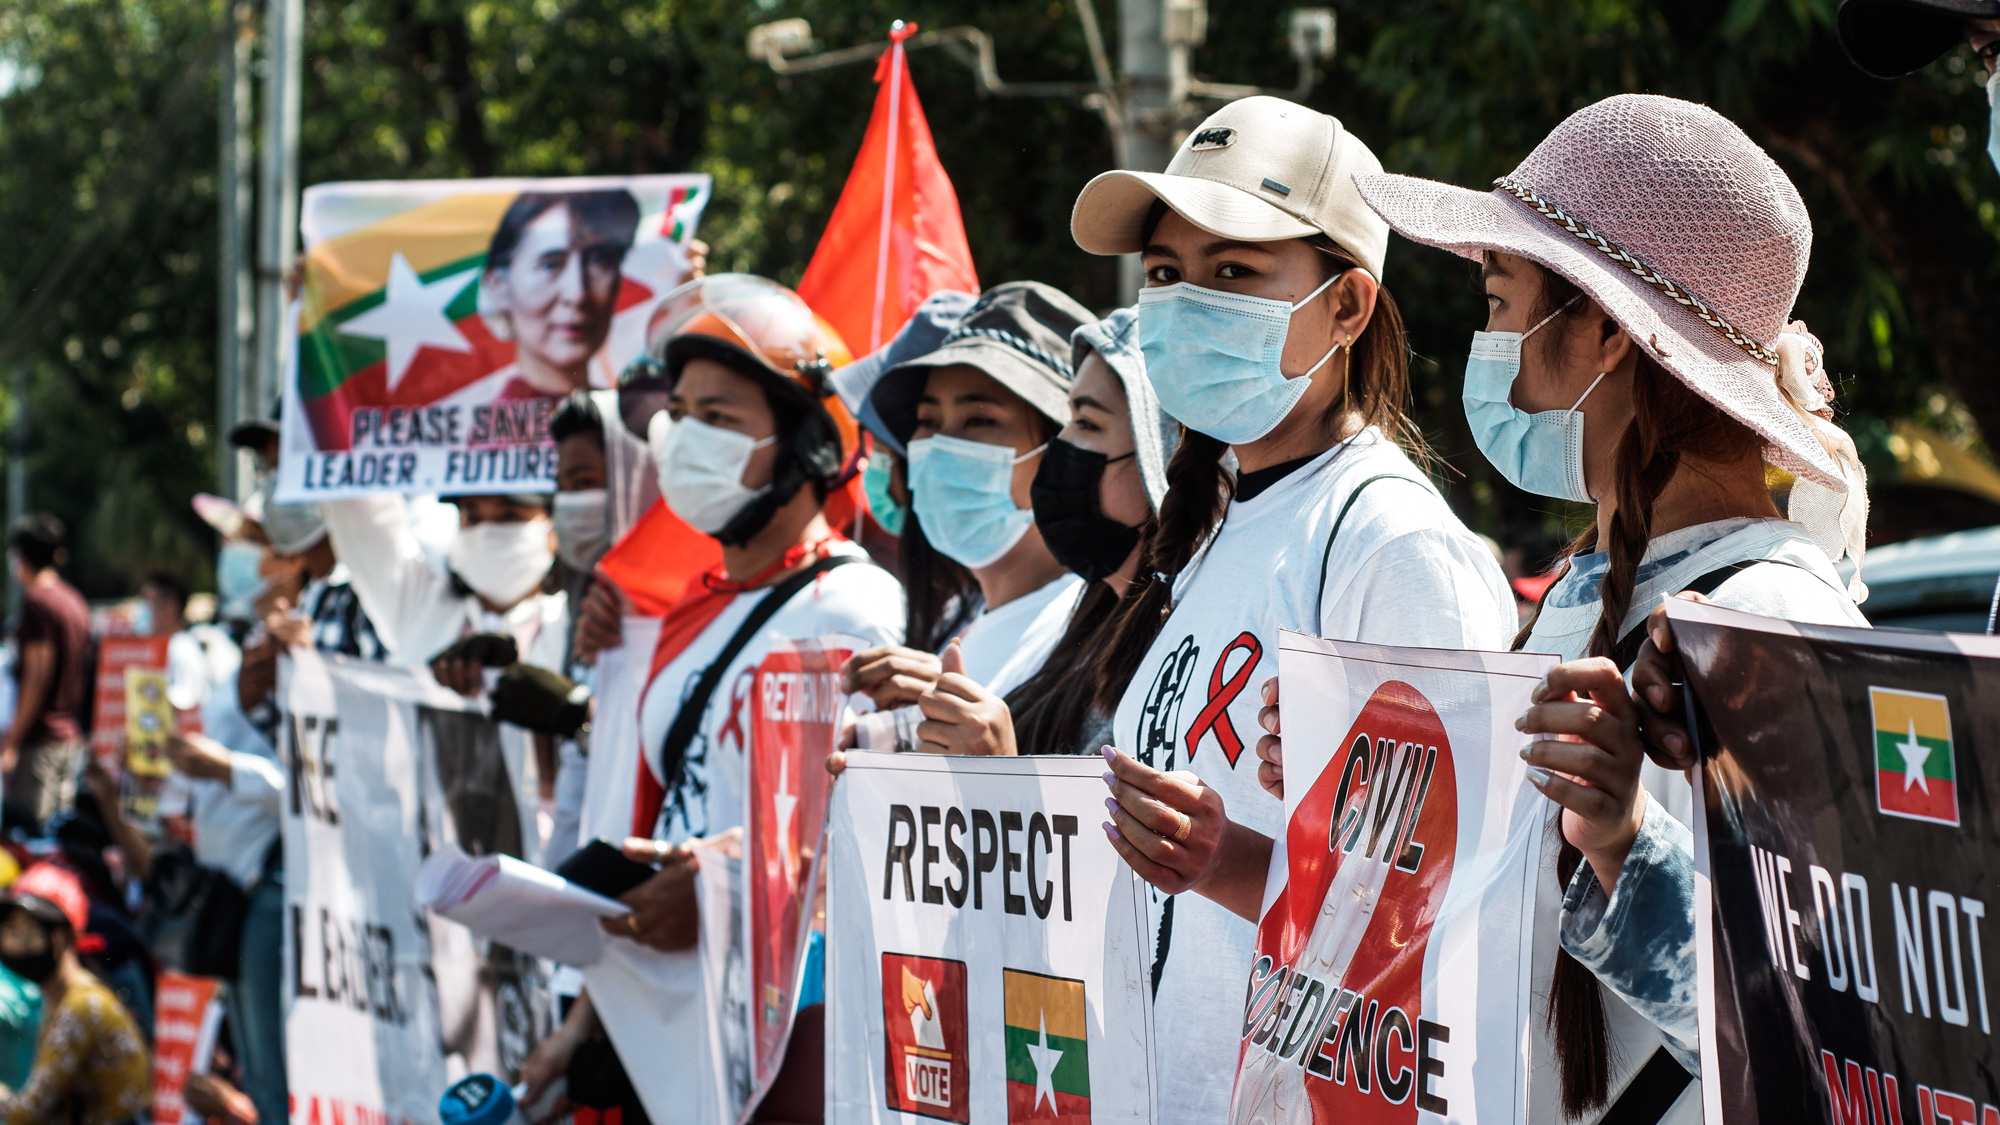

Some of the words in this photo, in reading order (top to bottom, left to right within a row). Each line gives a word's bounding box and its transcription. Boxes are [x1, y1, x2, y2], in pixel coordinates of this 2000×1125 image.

[353, 407, 462, 449] PLEASE
[473, 402, 552, 442] SAVE
[304, 453, 417, 489] LEADER
[445, 448, 557, 483] FUTURE
[763, 671, 818, 722] RETURN
[1329, 732, 1438, 875] CIVIL
[883, 803, 1078, 922] RESPECT
[1749, 843, 1811, 982] WE
[1809, 864, 1879, 1004] DO
[1890, 881, 1991, 1035] NOT
[1241, 951, 1451, 1117] SOBEDIENCE
[907, 1061, 949, 1103] VOTE
